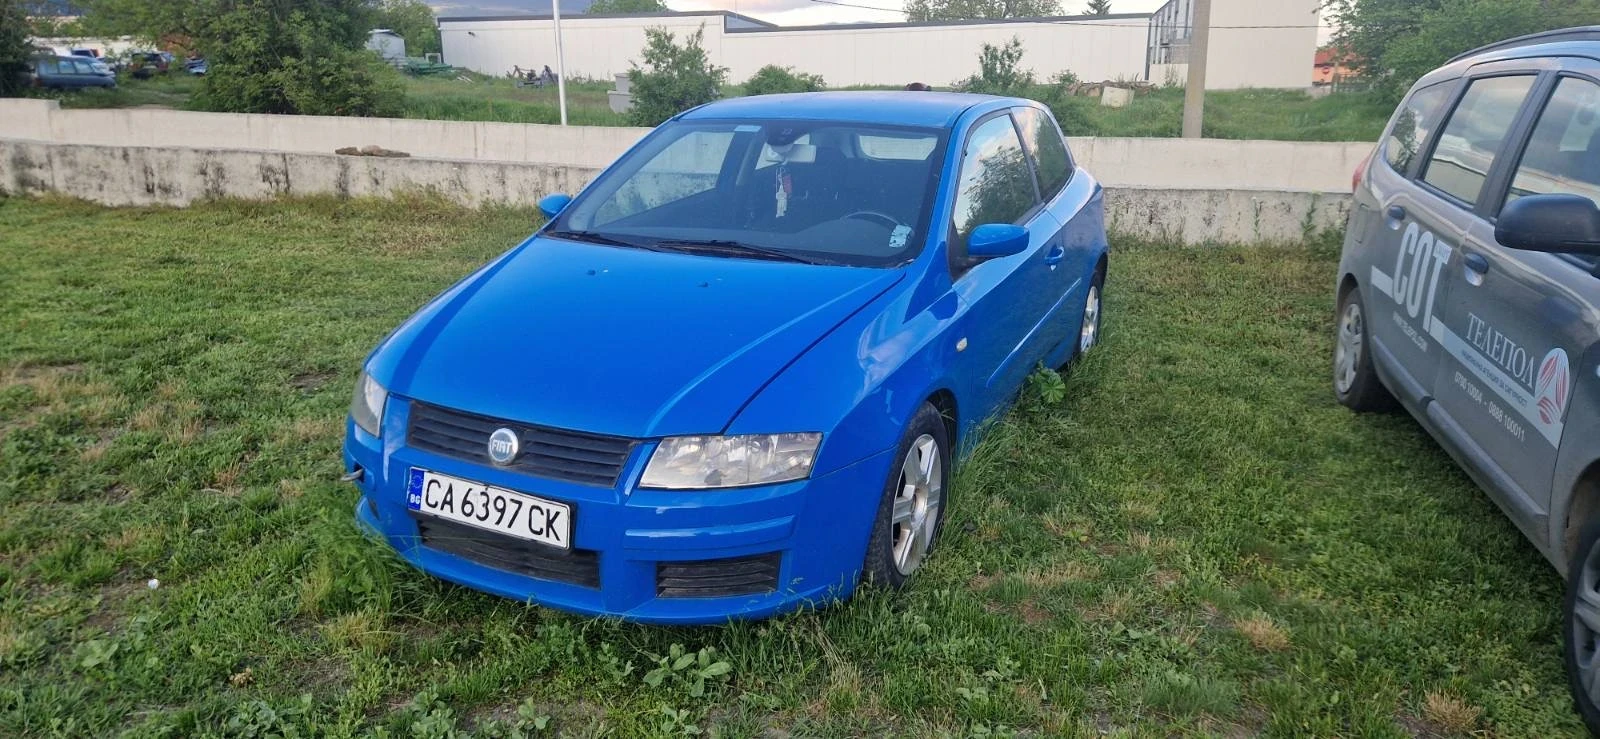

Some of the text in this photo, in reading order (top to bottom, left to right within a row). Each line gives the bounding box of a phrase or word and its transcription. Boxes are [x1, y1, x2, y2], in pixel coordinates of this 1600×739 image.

[1466, 312, 1535, 389] ТЕЛЕПОЛ
[491, 440, 513, 453] FIAT
[410, 493, 421, 505] BG
[425, 479, 561, 541] CA 6397 CK
